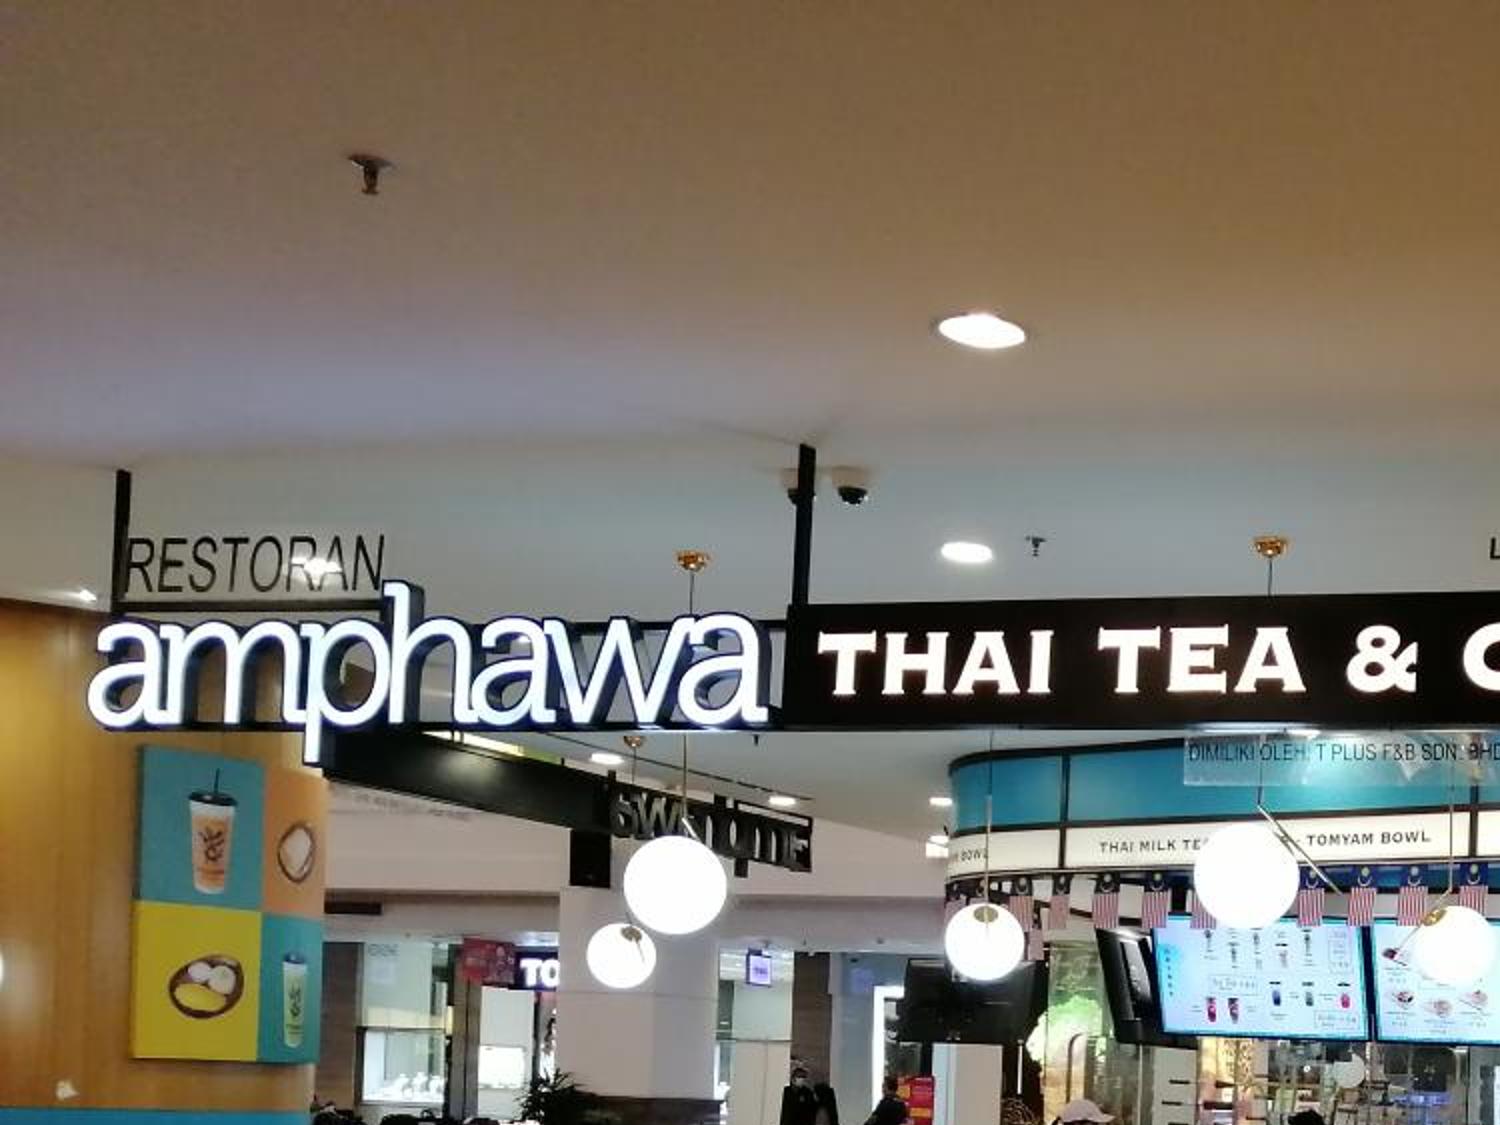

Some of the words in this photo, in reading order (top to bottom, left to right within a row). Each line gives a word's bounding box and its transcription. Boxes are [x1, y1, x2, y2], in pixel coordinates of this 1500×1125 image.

[124, 534, 384, 592] RESTORAN
[87, 580, 770, 764] amphawa
[818, 628, 1053, 696] THAI
[1098, 624, 1307, 694] TEA
[1346, 624, 1417, 694] &
[1189, 743, 1254, 761] DIMILIKI
[1316, 743, 1326, 761] T
[1332, 743, 1377, 761] PLUS
[1382, 743, 1416, 761] F&B
[1100, 841, 1134, 853] THAI
[1138, 839, 1177, 851] MILK
[1306, 832, 1374, 846] TOMYAM
[1380, 829, 1431, 844] BOWL
